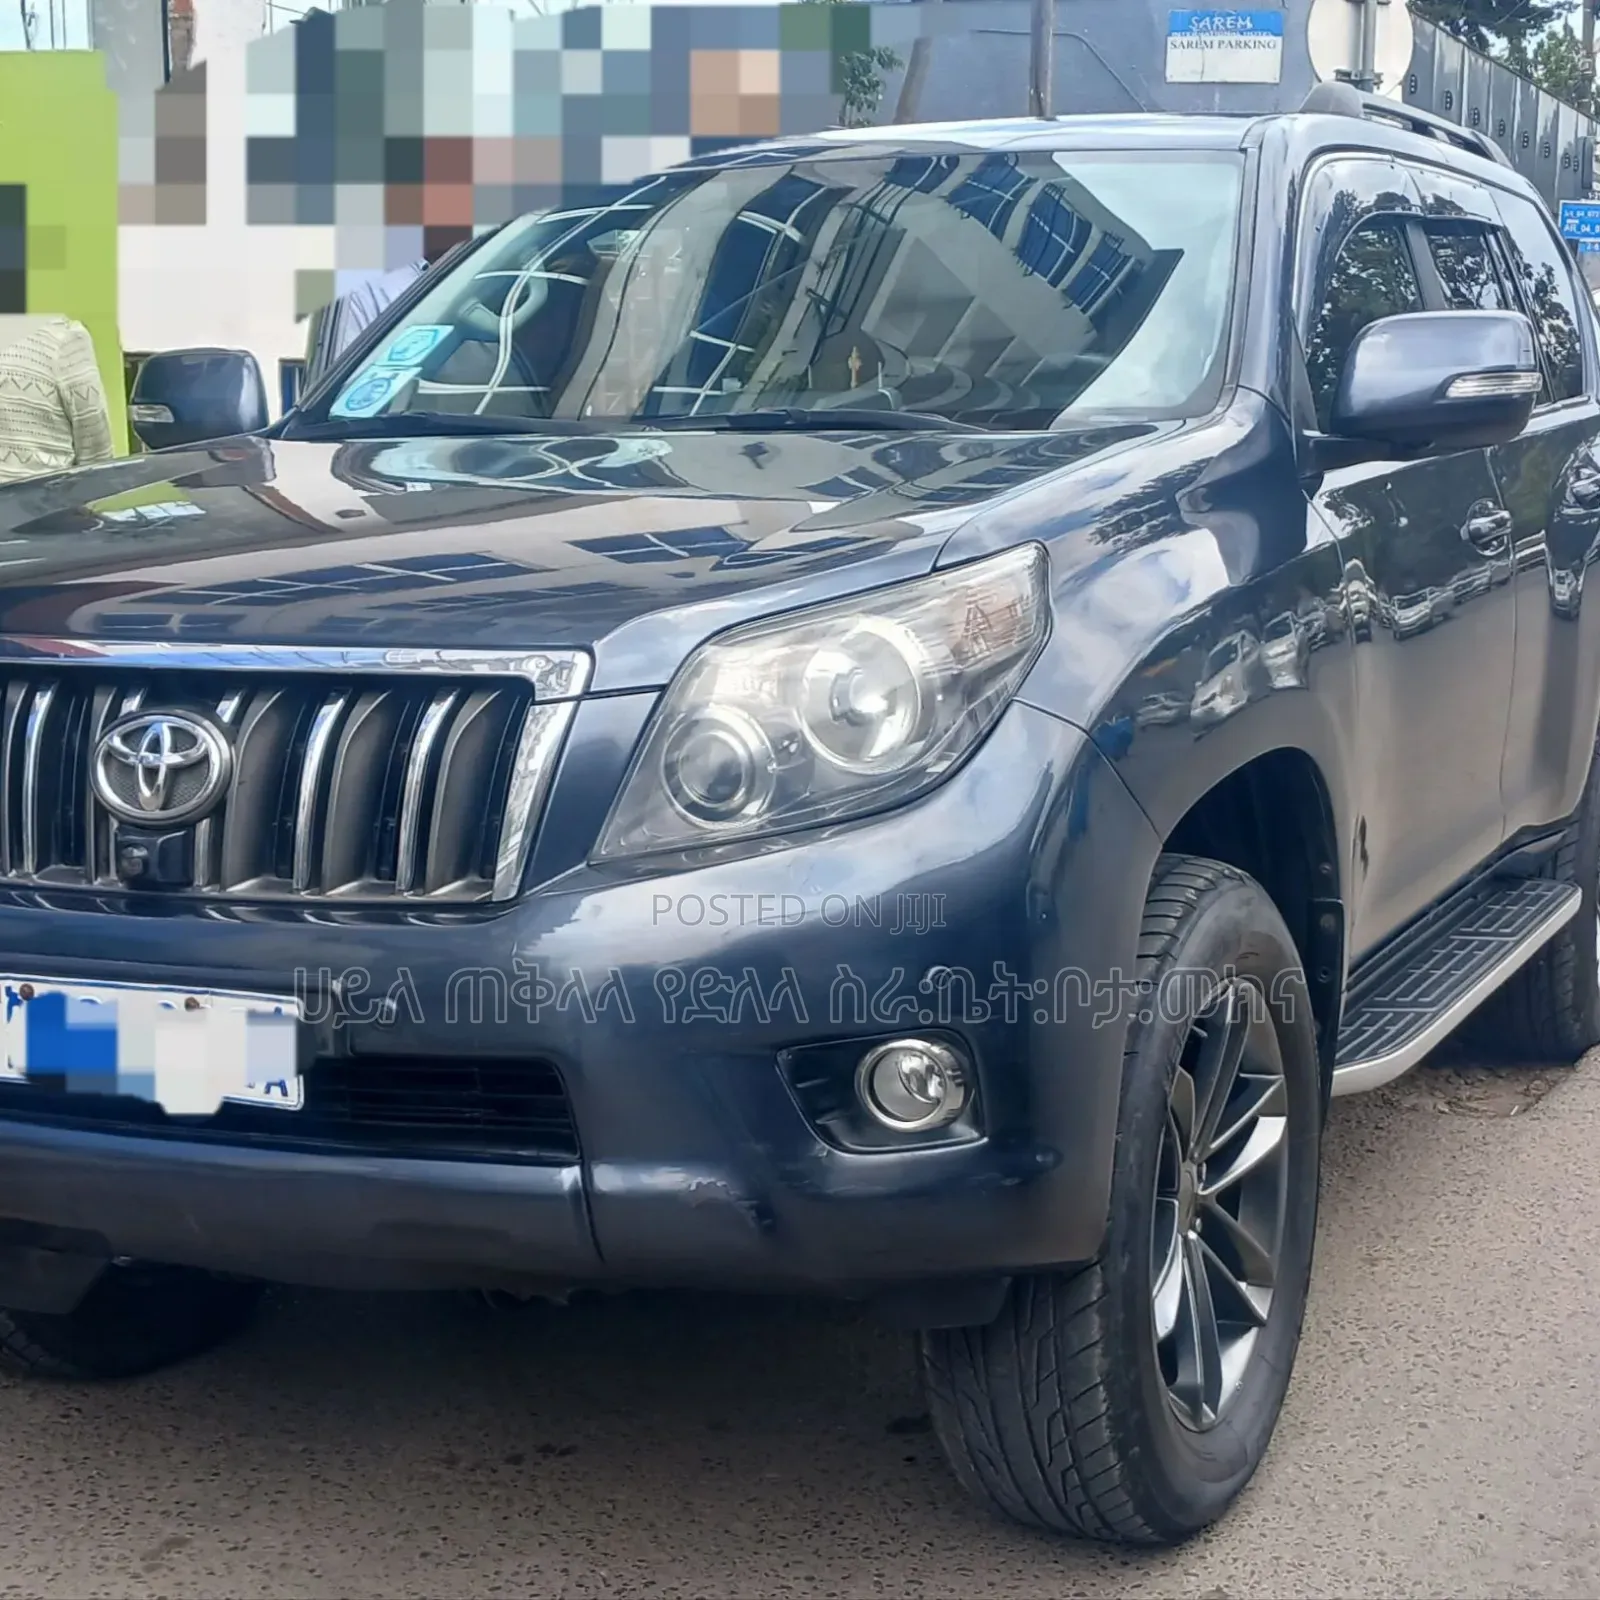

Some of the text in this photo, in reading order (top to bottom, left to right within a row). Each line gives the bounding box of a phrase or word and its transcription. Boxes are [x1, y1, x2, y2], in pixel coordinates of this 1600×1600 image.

[1188, 15, 1253, 31] SAREM
[1170, 39, 1276, 50] SAREM PARKING
